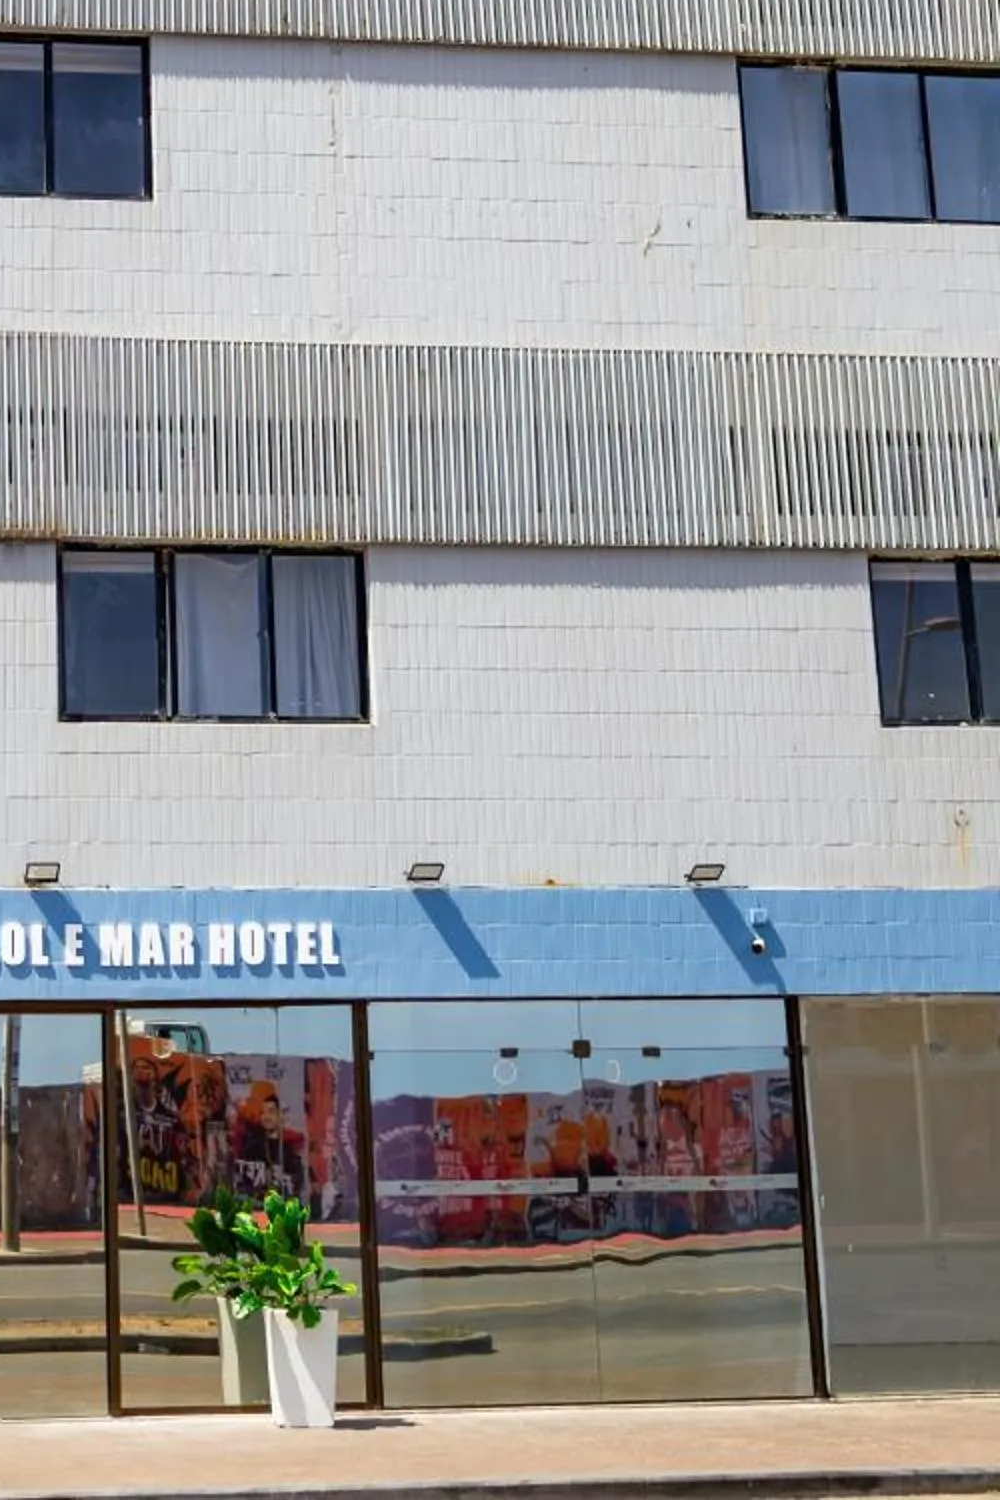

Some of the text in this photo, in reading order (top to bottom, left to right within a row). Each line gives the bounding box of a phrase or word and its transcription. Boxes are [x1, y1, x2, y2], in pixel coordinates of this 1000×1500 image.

[65, 922, 84, 965] E
[101, 922, 194, 966] MAR
[210, 921, 339, 965] HOTEL
